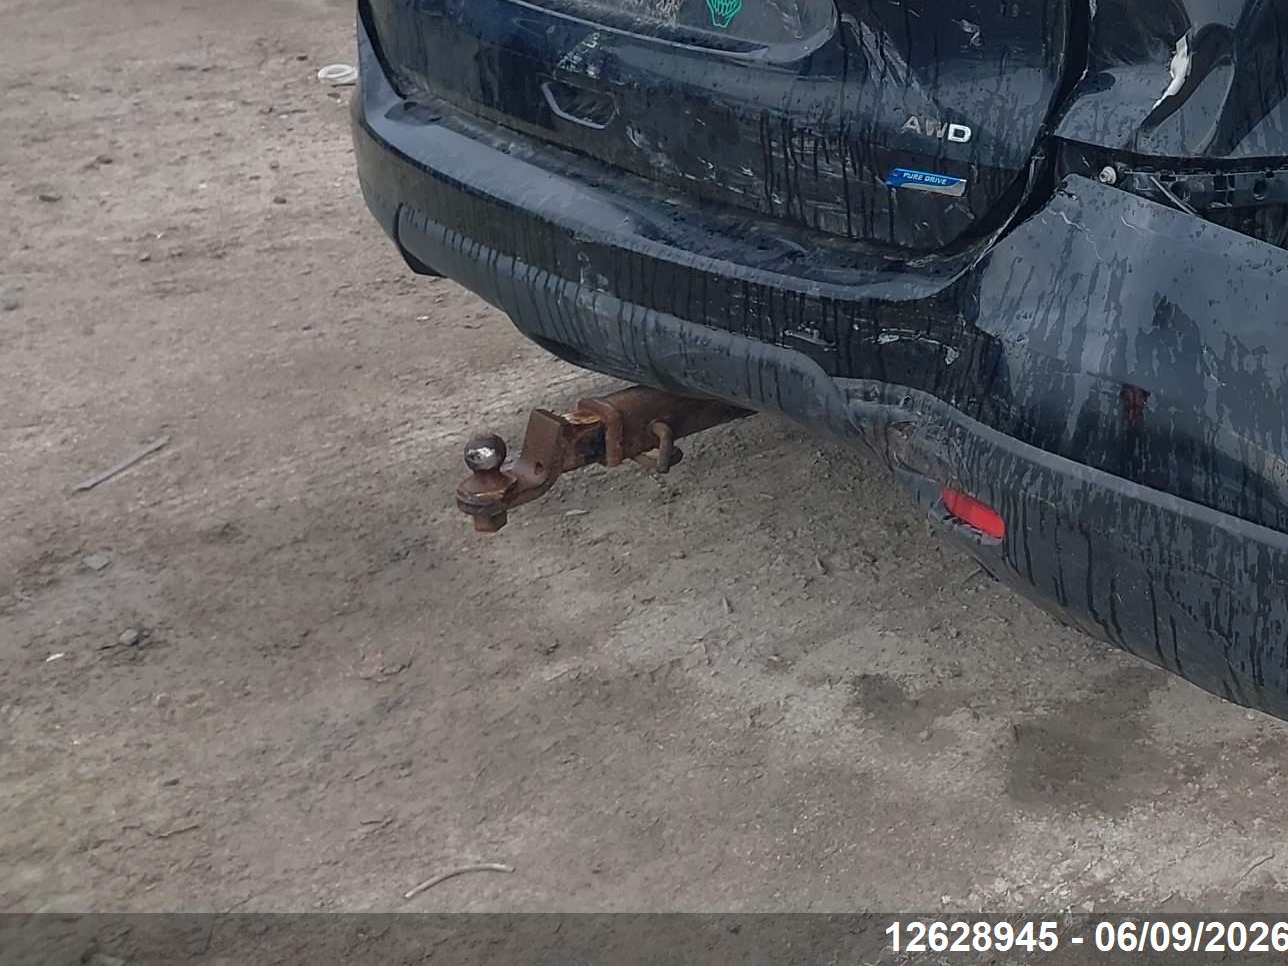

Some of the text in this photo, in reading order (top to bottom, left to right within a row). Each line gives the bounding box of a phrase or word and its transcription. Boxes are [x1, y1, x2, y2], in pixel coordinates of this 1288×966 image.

[901, 116, 972, 143] AWD
[903, 172, 947, 185] PURE DRIVE
